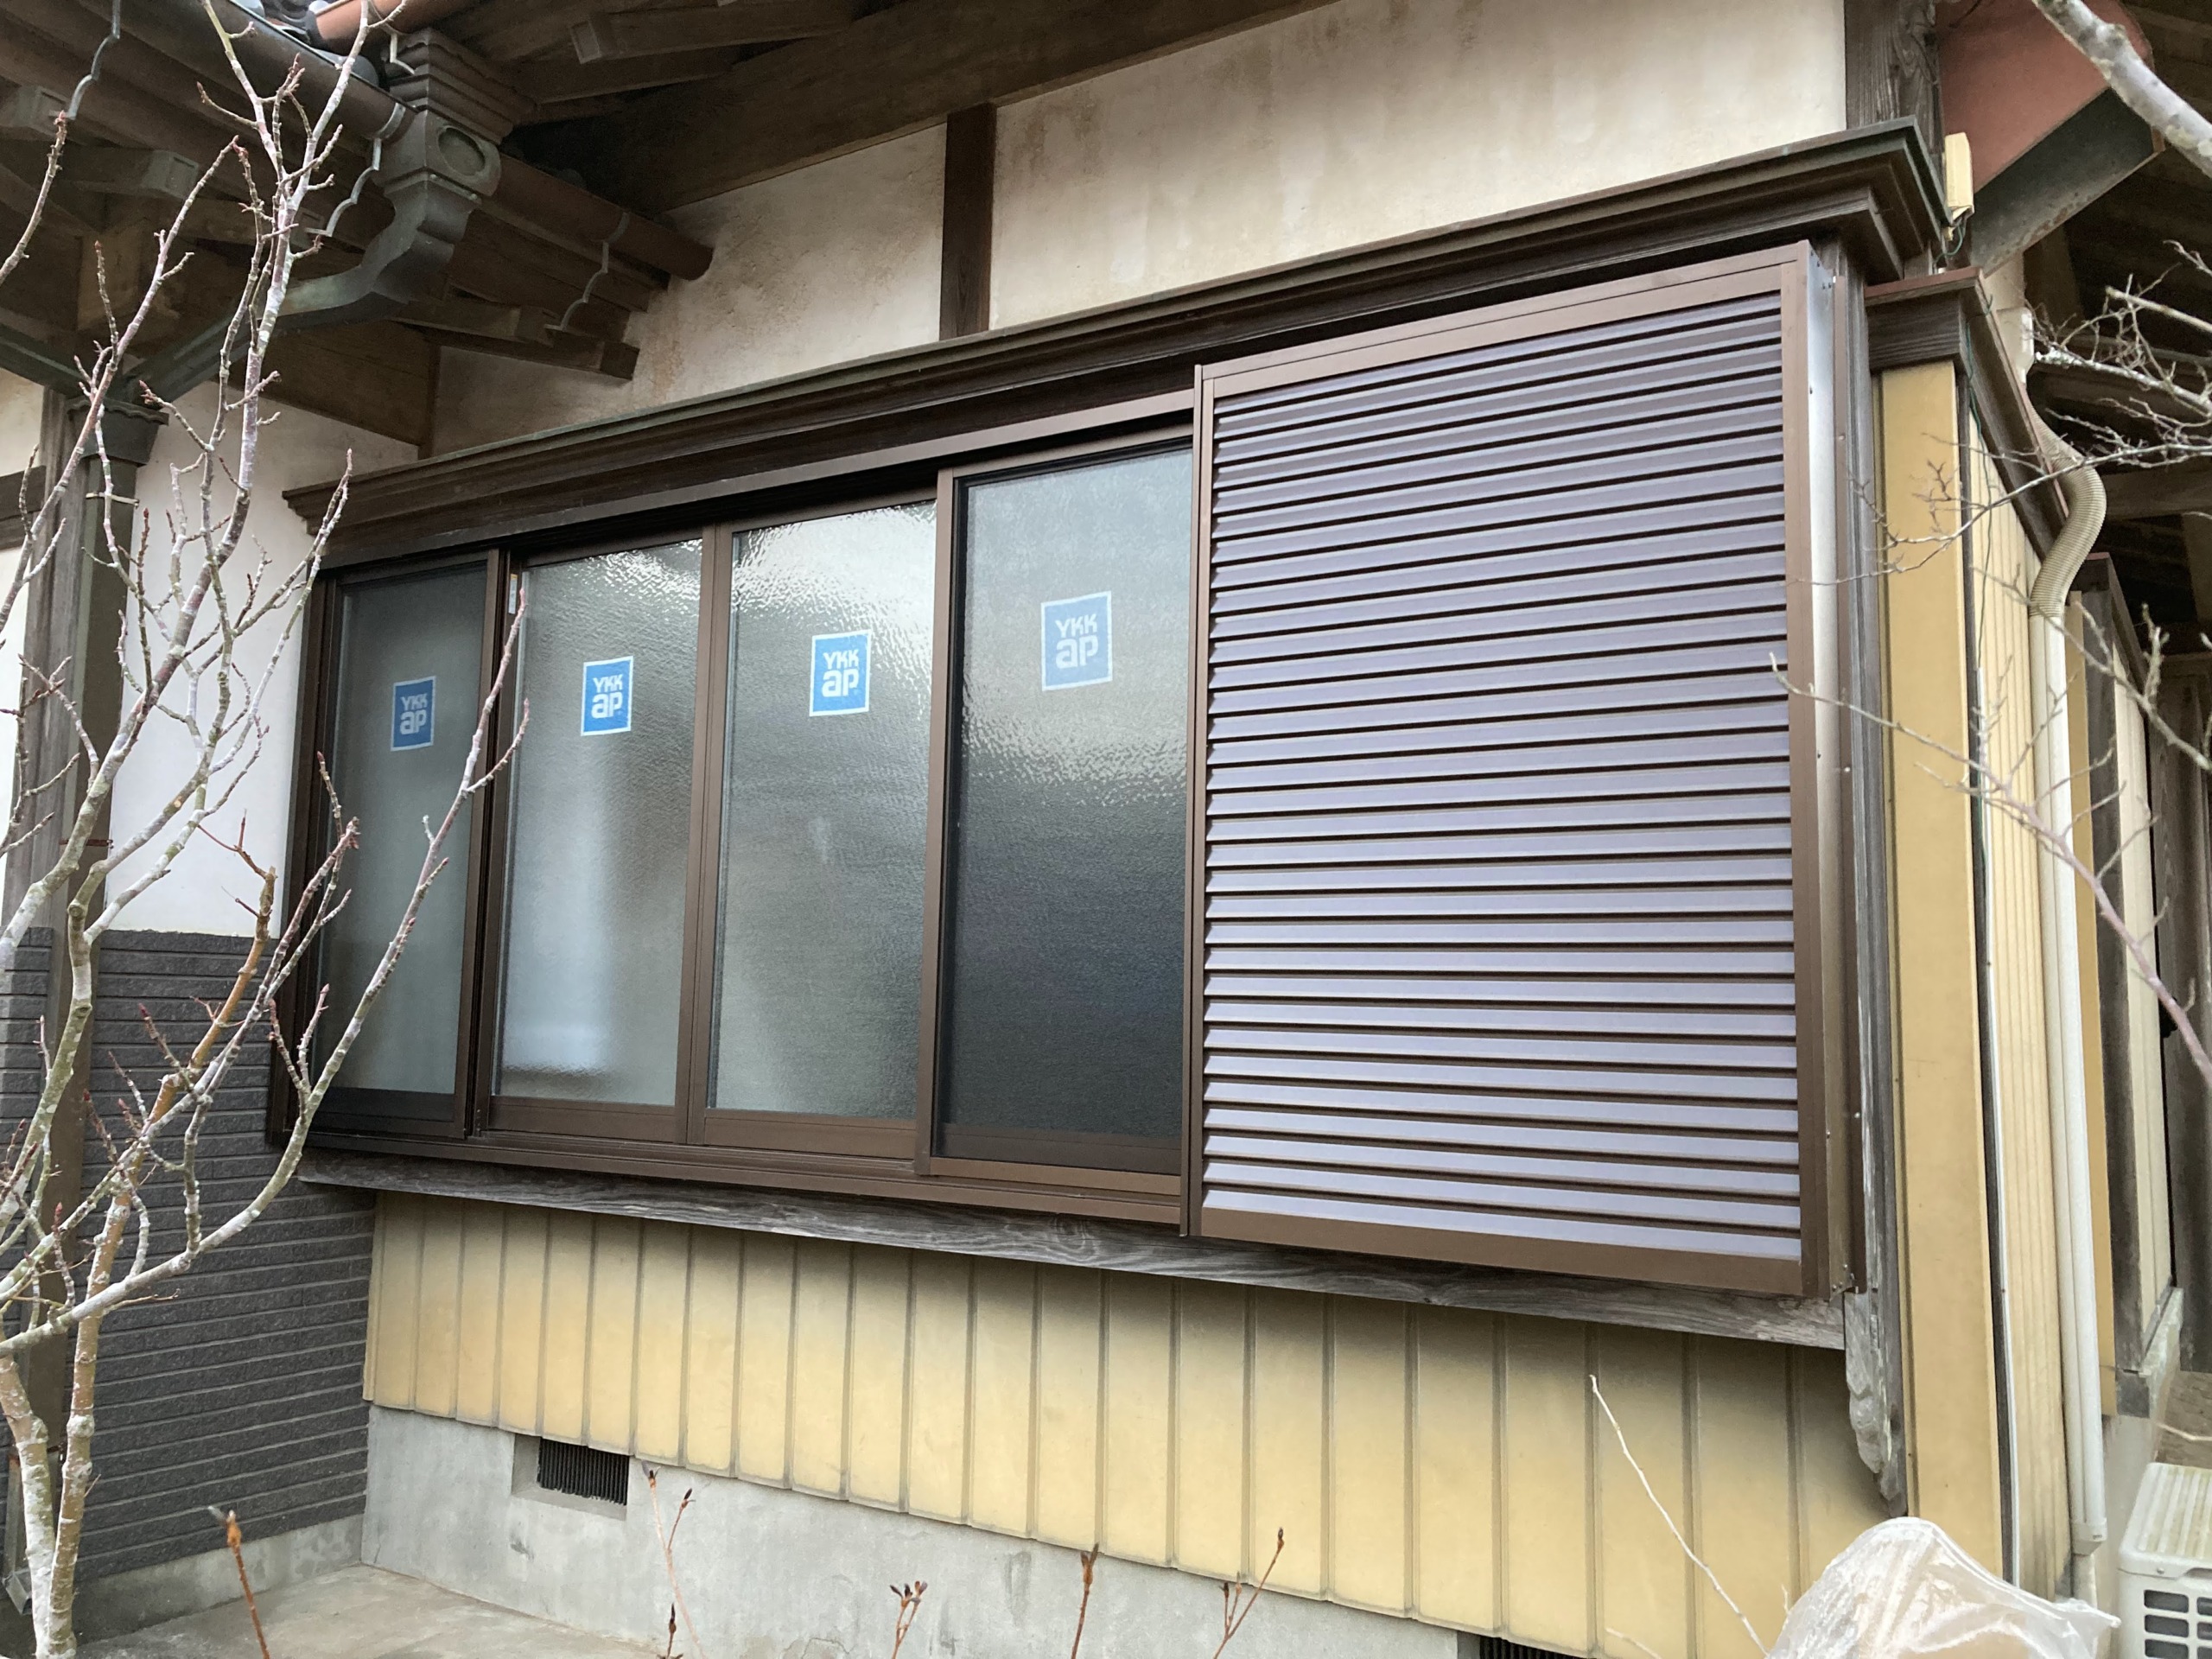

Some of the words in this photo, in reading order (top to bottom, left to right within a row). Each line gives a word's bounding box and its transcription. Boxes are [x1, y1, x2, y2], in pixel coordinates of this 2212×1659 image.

[1055, 613, 1097, 638] YKK
[823, 649, 860, 669] YKK
[1055, 635, 1098, 669] ap
[592, 674, 623, 693] YKK
[821, 668, 860, 696] ap
[401, 693, 428, 710] YKK
[591, 691, 623, 718] ap
[400, 709, 428, 734] ap
